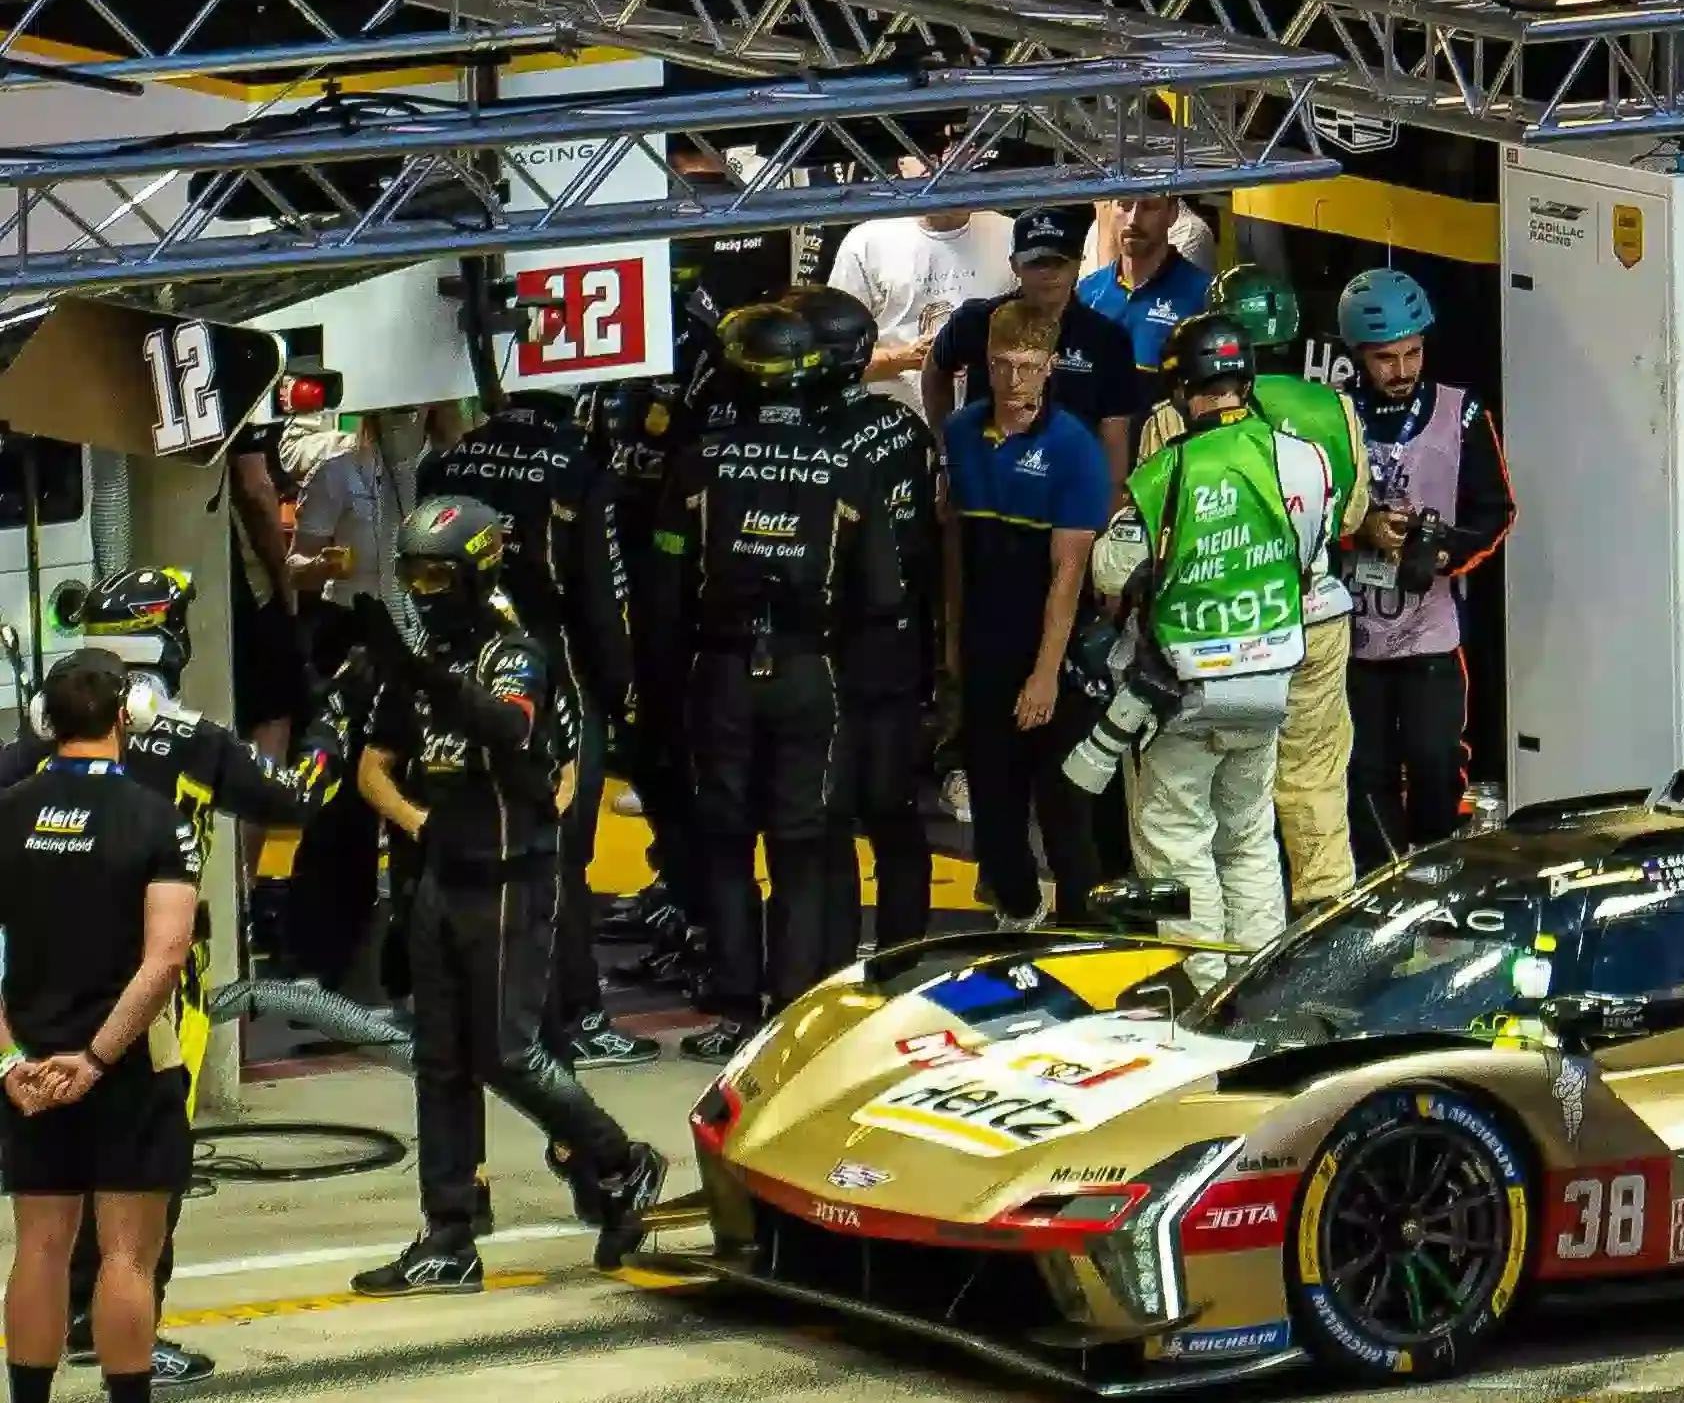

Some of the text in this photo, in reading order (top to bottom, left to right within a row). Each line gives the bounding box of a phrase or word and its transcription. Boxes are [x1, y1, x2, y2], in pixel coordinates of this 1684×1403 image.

[1528, 219, 1585, 239] CADILLAC
[1528, 231, 1572, 249] RACING
[541, 266, 625, 364] 12
[1303, 338, 1361, 389] He
[142, 320, 227, 457] 12
[702, 442, 850, 468] CADILLAC
[446, 462, 546, 483] RACING
[718, 463, 832, 485] RACING
[741, 509, 801, 533] Hertz
[731, 539, 808, 559] Racing Gold
[1196, 523, 1251, 559] MEDIA
[1169, 579, 1292, 634] 1095
[34, 804, 92, 833] Hertz
[24, 836, 96, 854] Racing Gold
[888, 1080, 1081, 1141] Hertz
[1049, 1165, 1106, 1183] Mobil
[811, 1200, 862, 1230] JOTA
[1195, 1201, 1279, 1230] JOTA
[1556, 1173, 1646, 1260] 38
[1187, 1330, 1278, 1352] MICHELIN
